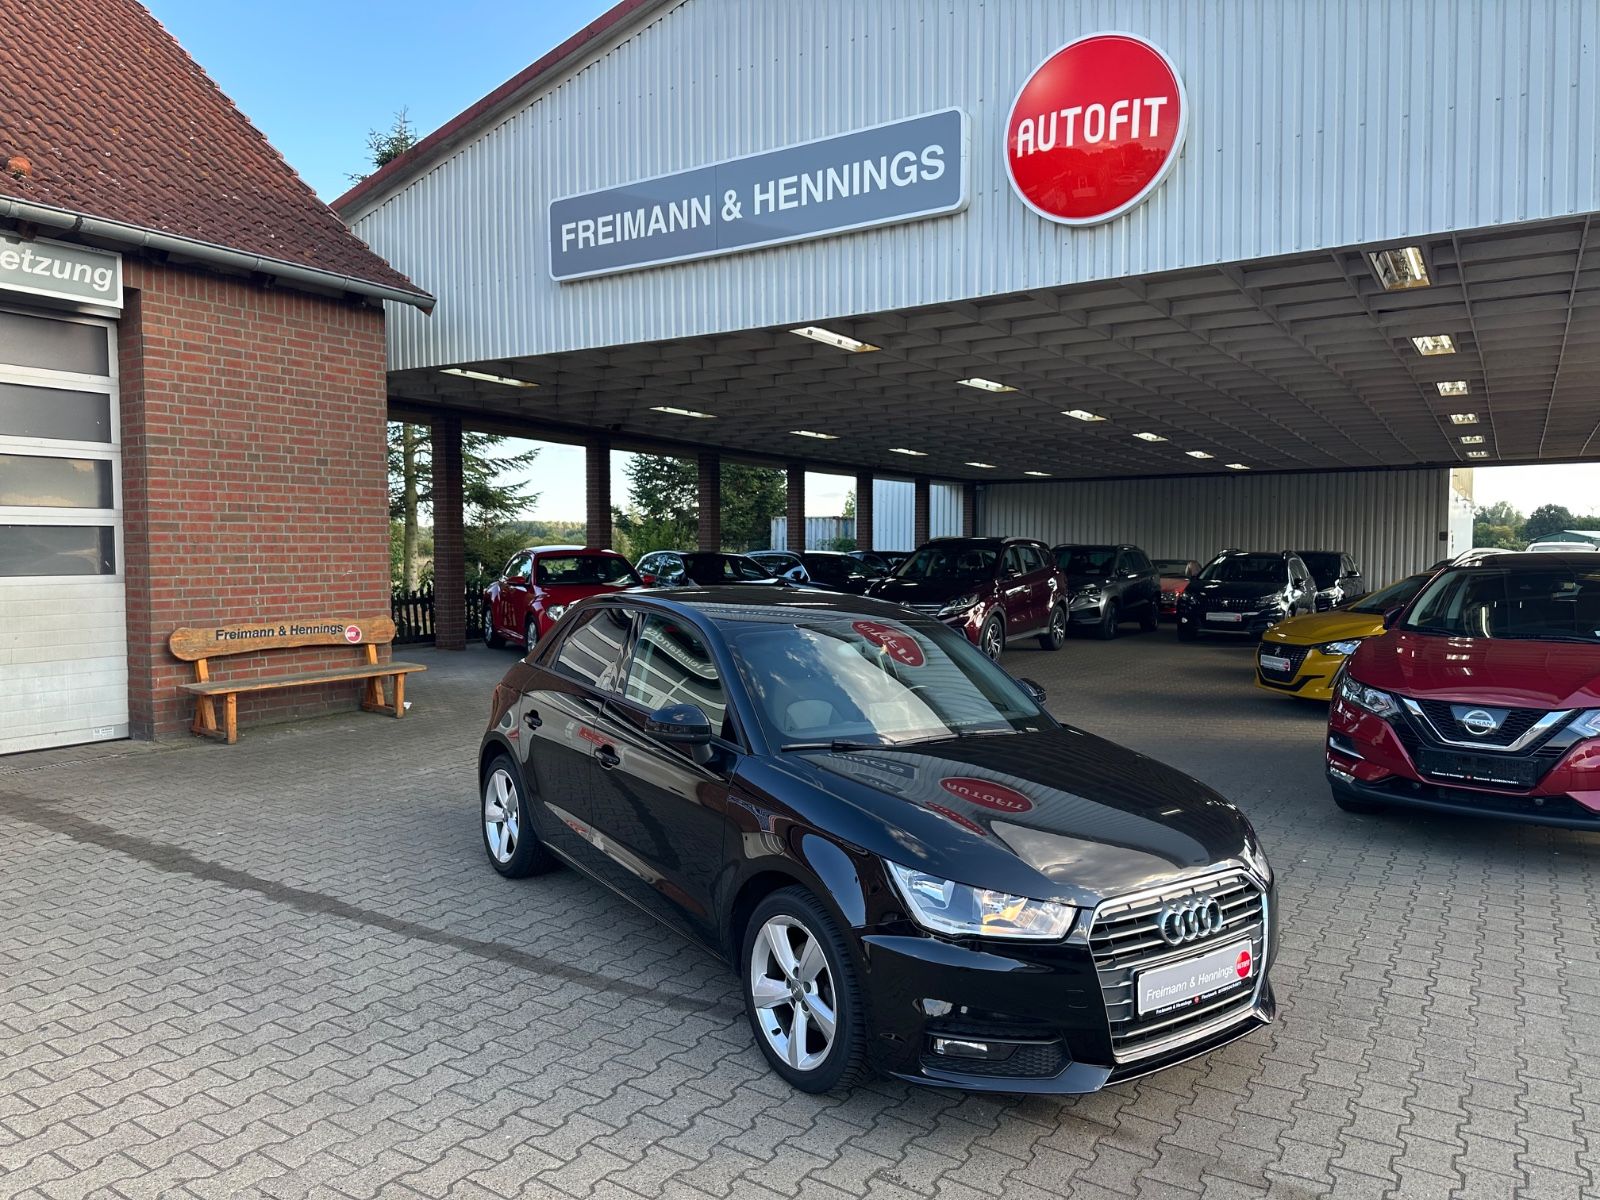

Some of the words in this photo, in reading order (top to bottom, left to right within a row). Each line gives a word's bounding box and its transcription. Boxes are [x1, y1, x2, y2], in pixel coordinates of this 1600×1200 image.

[1015, 96, 1168, 158] AUTOFIT
[561, 194, 711, 253] FREIMANN
[721, 188, 743, 222] &
[753, 144, 946, 216] HENNINGS
[0, 249, 113, 292] etzung
[215, 628, 275, 641] Freimann
[278, 626, 287, 636] &
[290, 623, 344, 636] Hennings
[1464, 718, 1491, 727] NISSAN
[1146, 981, 1187, 1001] Freimann
[1190, 977, 1196, 988] &
[1198, 966, 1234, 984] Hennings
